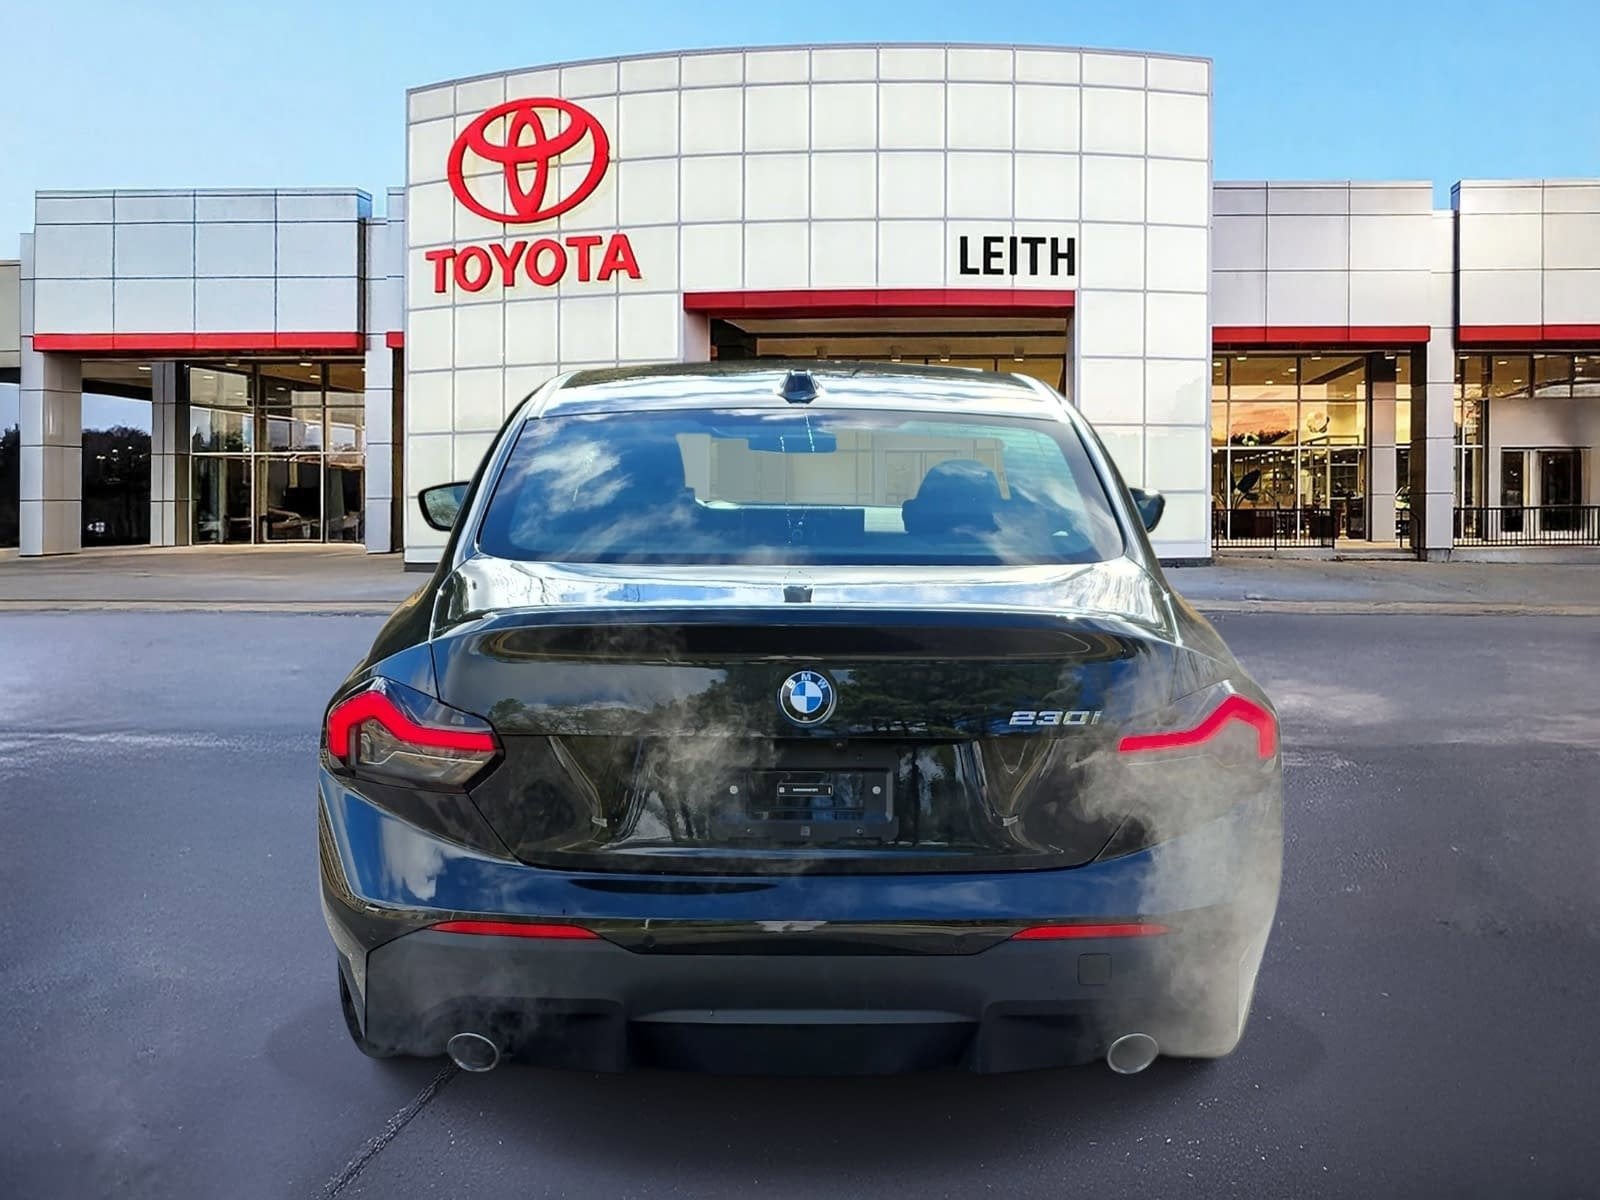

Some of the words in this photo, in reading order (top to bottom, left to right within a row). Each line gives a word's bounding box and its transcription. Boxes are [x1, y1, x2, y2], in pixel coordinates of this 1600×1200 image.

[425, 234, 641, 293] TOYOTA
[960, 236, 1075, 276] LEITH
[785, 673, 828, 689] BMW
[1009, 710, 1103, 725] 230i
